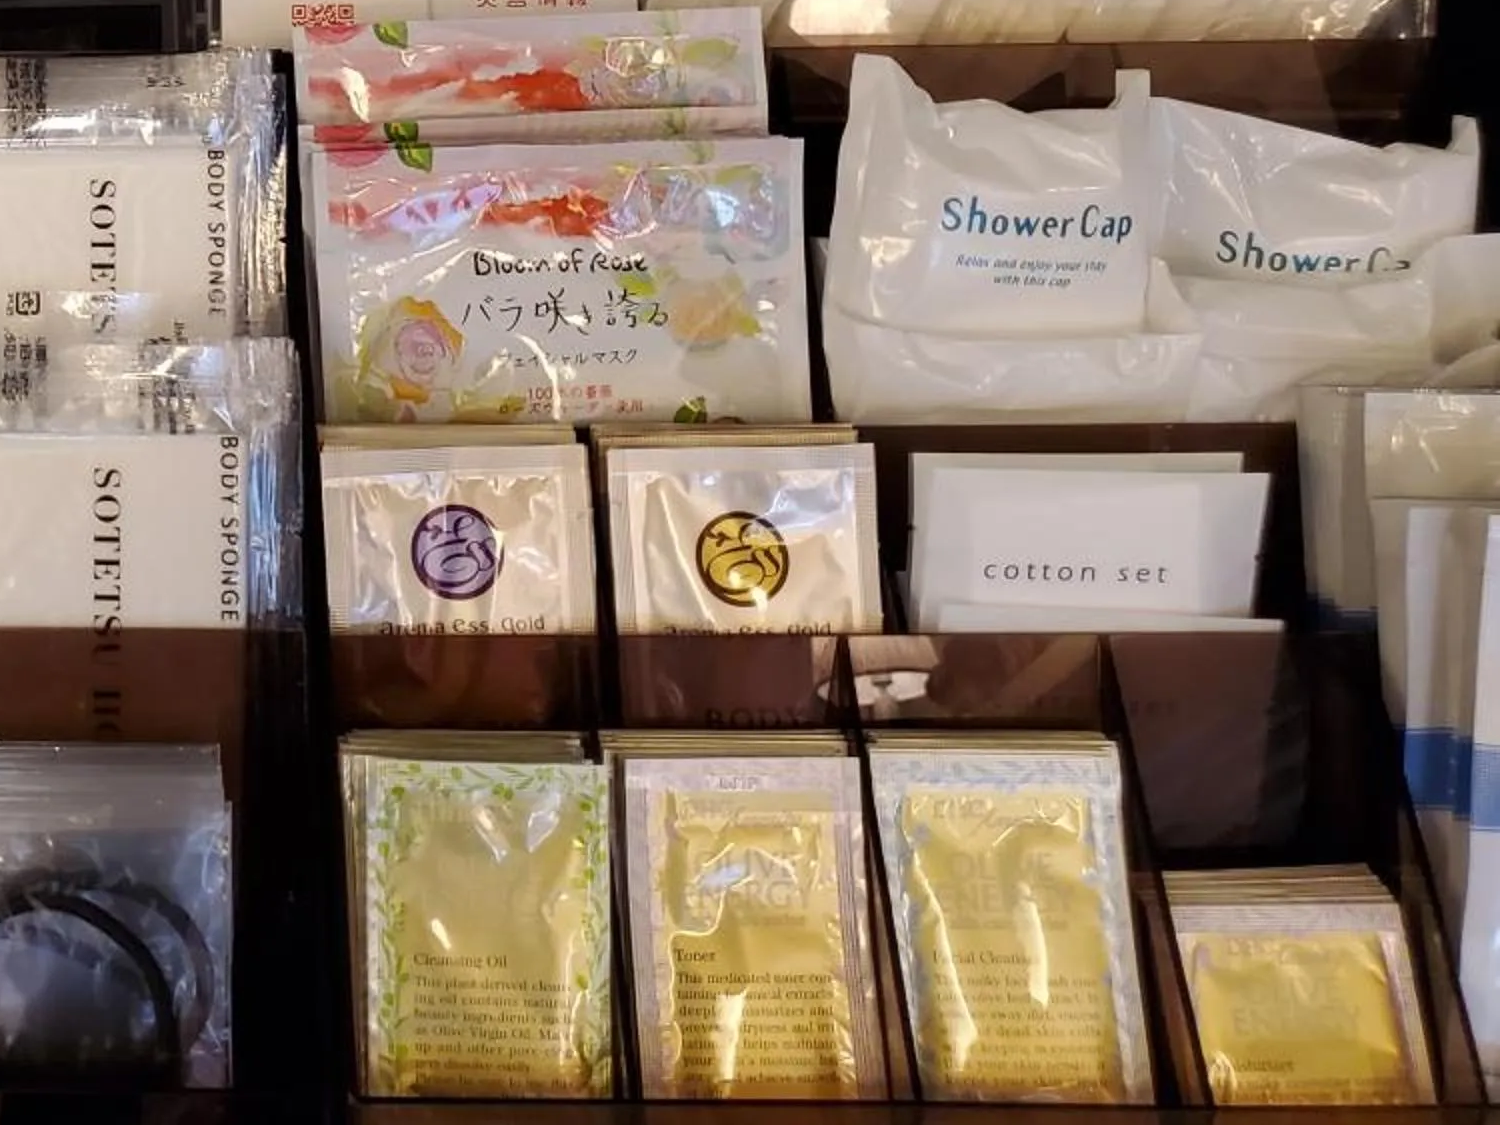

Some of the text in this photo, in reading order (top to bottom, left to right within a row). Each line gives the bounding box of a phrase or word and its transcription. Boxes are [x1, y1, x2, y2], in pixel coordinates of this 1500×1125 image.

[207, 149, 226, 317] BODY SPONGE
[558, 248, 583, 273] of
[589, 251, 648, 273] Rose
[220, 435, 240, 621] BODY SPONGE
[982, 560, 1169, 585] cotton set
